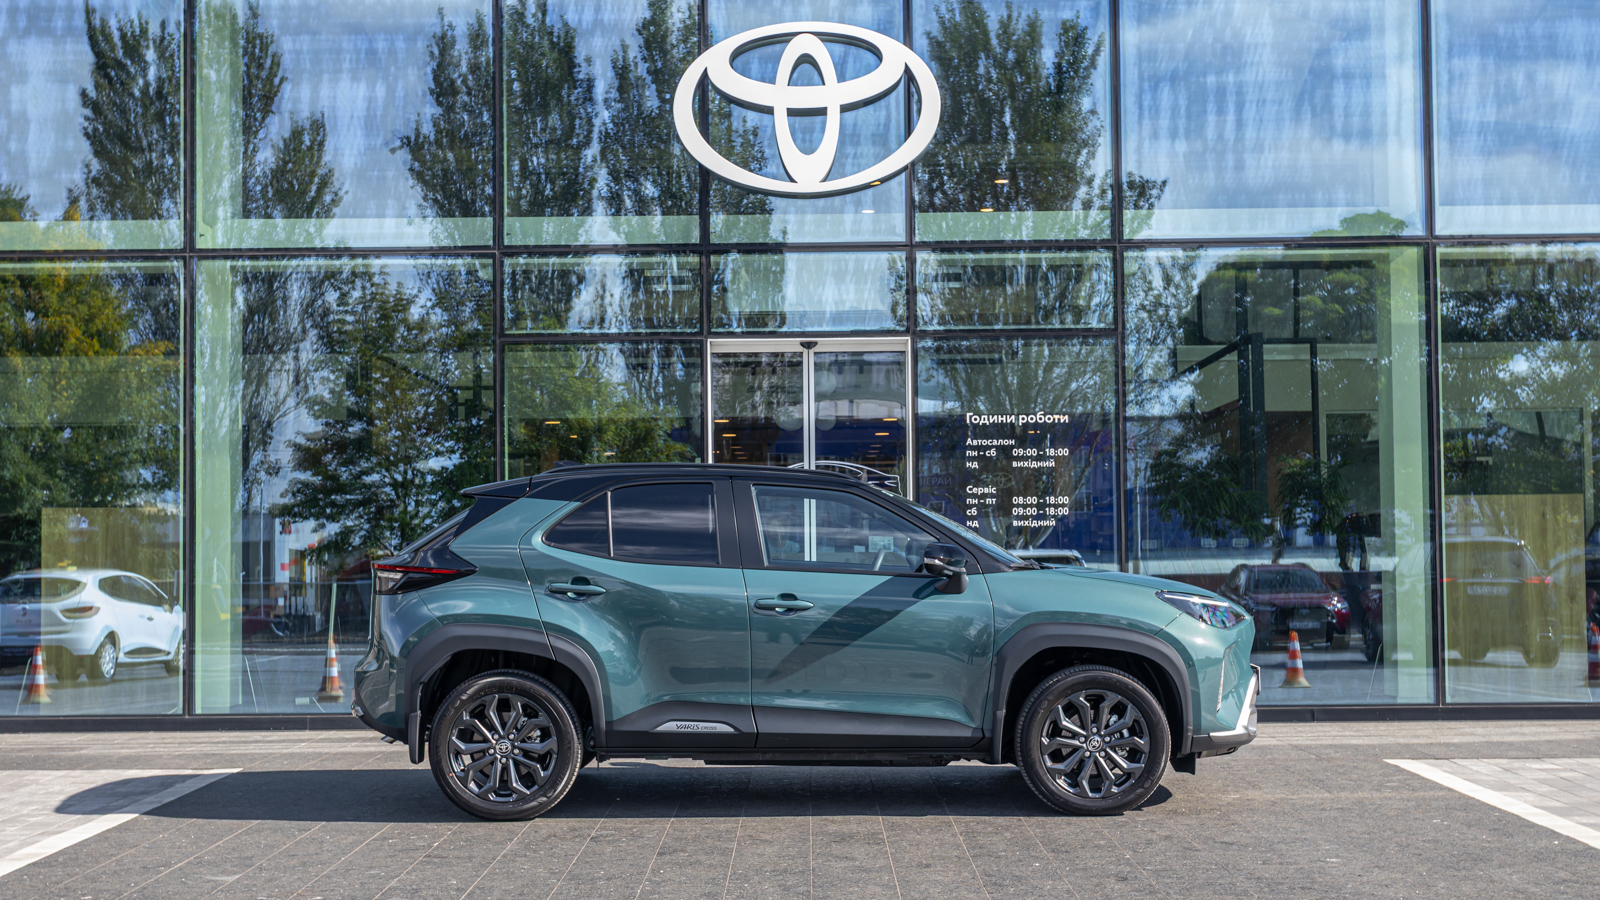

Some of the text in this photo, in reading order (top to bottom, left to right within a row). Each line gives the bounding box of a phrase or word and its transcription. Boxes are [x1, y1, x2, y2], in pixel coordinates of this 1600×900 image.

[966, 411, 1069, 426] Години роботи
[966, 437, 1015, 446] Автосалон
[985, 448, 997, 457] сб
[1012, 448, 1038, 456] 09:00
[1045, 448, 1069, 456] 18:00
[966, 459, 1056, 469] нд вихідний
[966, 485, 997, 495] Сервіс
[1012, 496, 1038, 505] 08:00
[1045, 496, 1069, 505] 18:00
[966, 507, 978, 516] сб
[1012, 507, 1038, 516] 09:00
[1045, 507, 1069, 516] 18:00
[966, 518, 1056, 528] нд вихідний
